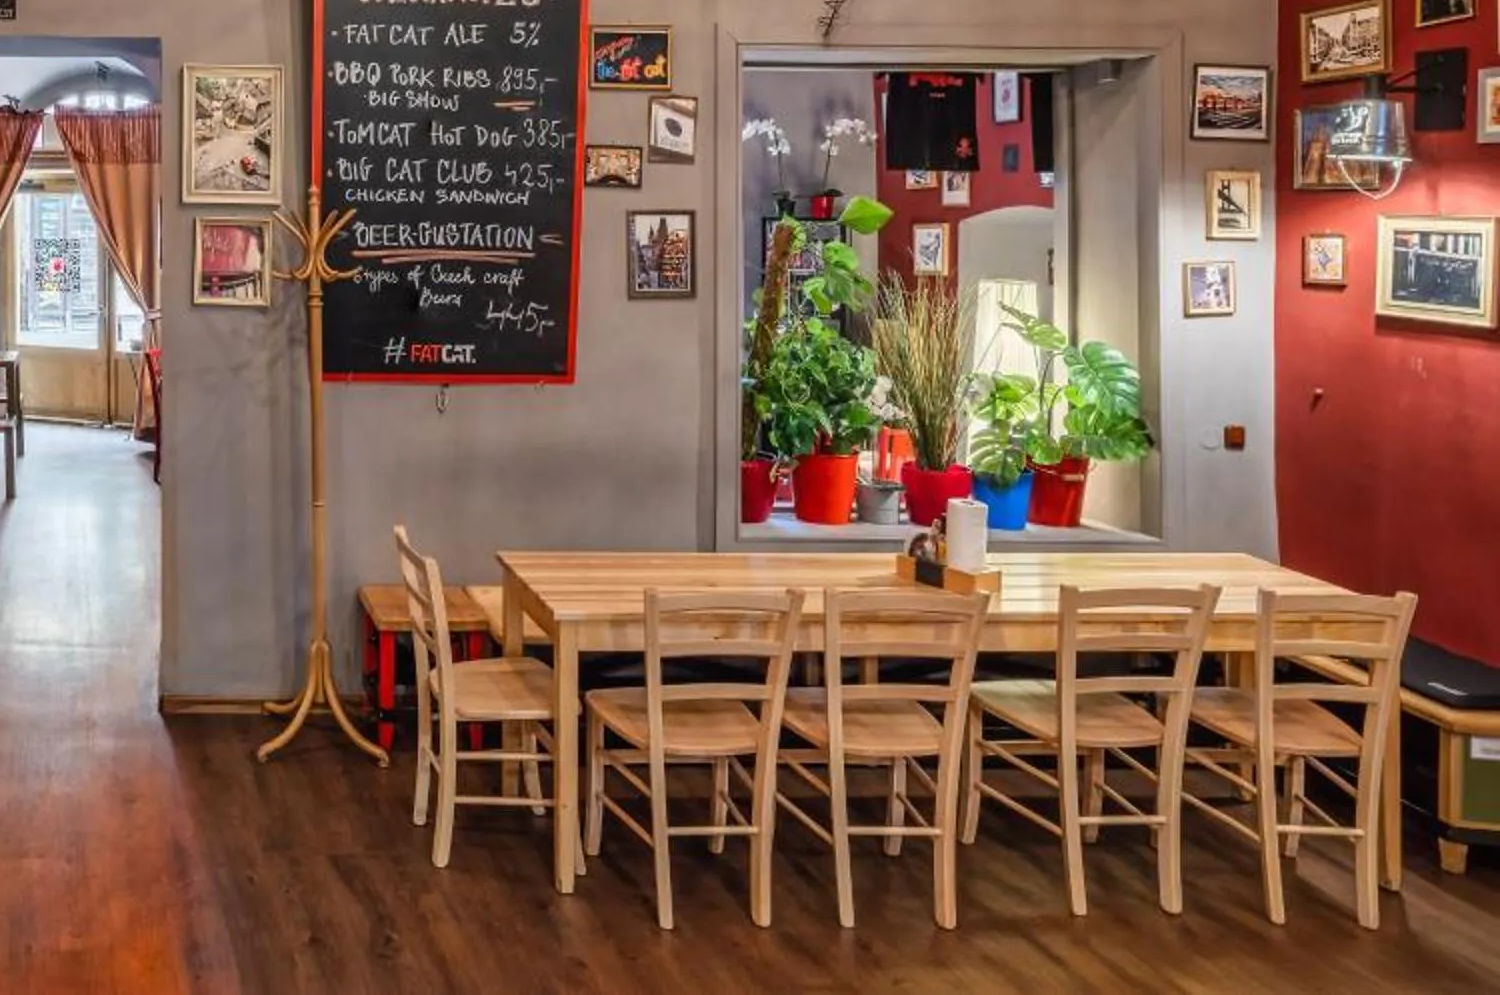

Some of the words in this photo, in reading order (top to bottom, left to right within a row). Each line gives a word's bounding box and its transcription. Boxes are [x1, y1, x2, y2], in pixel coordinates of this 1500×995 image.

[443, 22, 488, 46] ALE
[508, 20, 541, 48] 5%
[333, 61, 381, 87] BBQ
[443, 66, 491, 88] RIBS
[368, 90, 401, 106] BIG
[405, 89, 460, 112] SHOW
[474, 124, 518, 147] DOG
[337, 156, 374, 182] BIG
[385, 157, 428, 184] CAT
[436, 158, 493, 185] CLUB
[345, 188, 425, 203] CHICKEN
[435, 189, 530, 205] SANDWICH
[407, 265, 425, 290] of
[483, 268, 525, 295] craft
